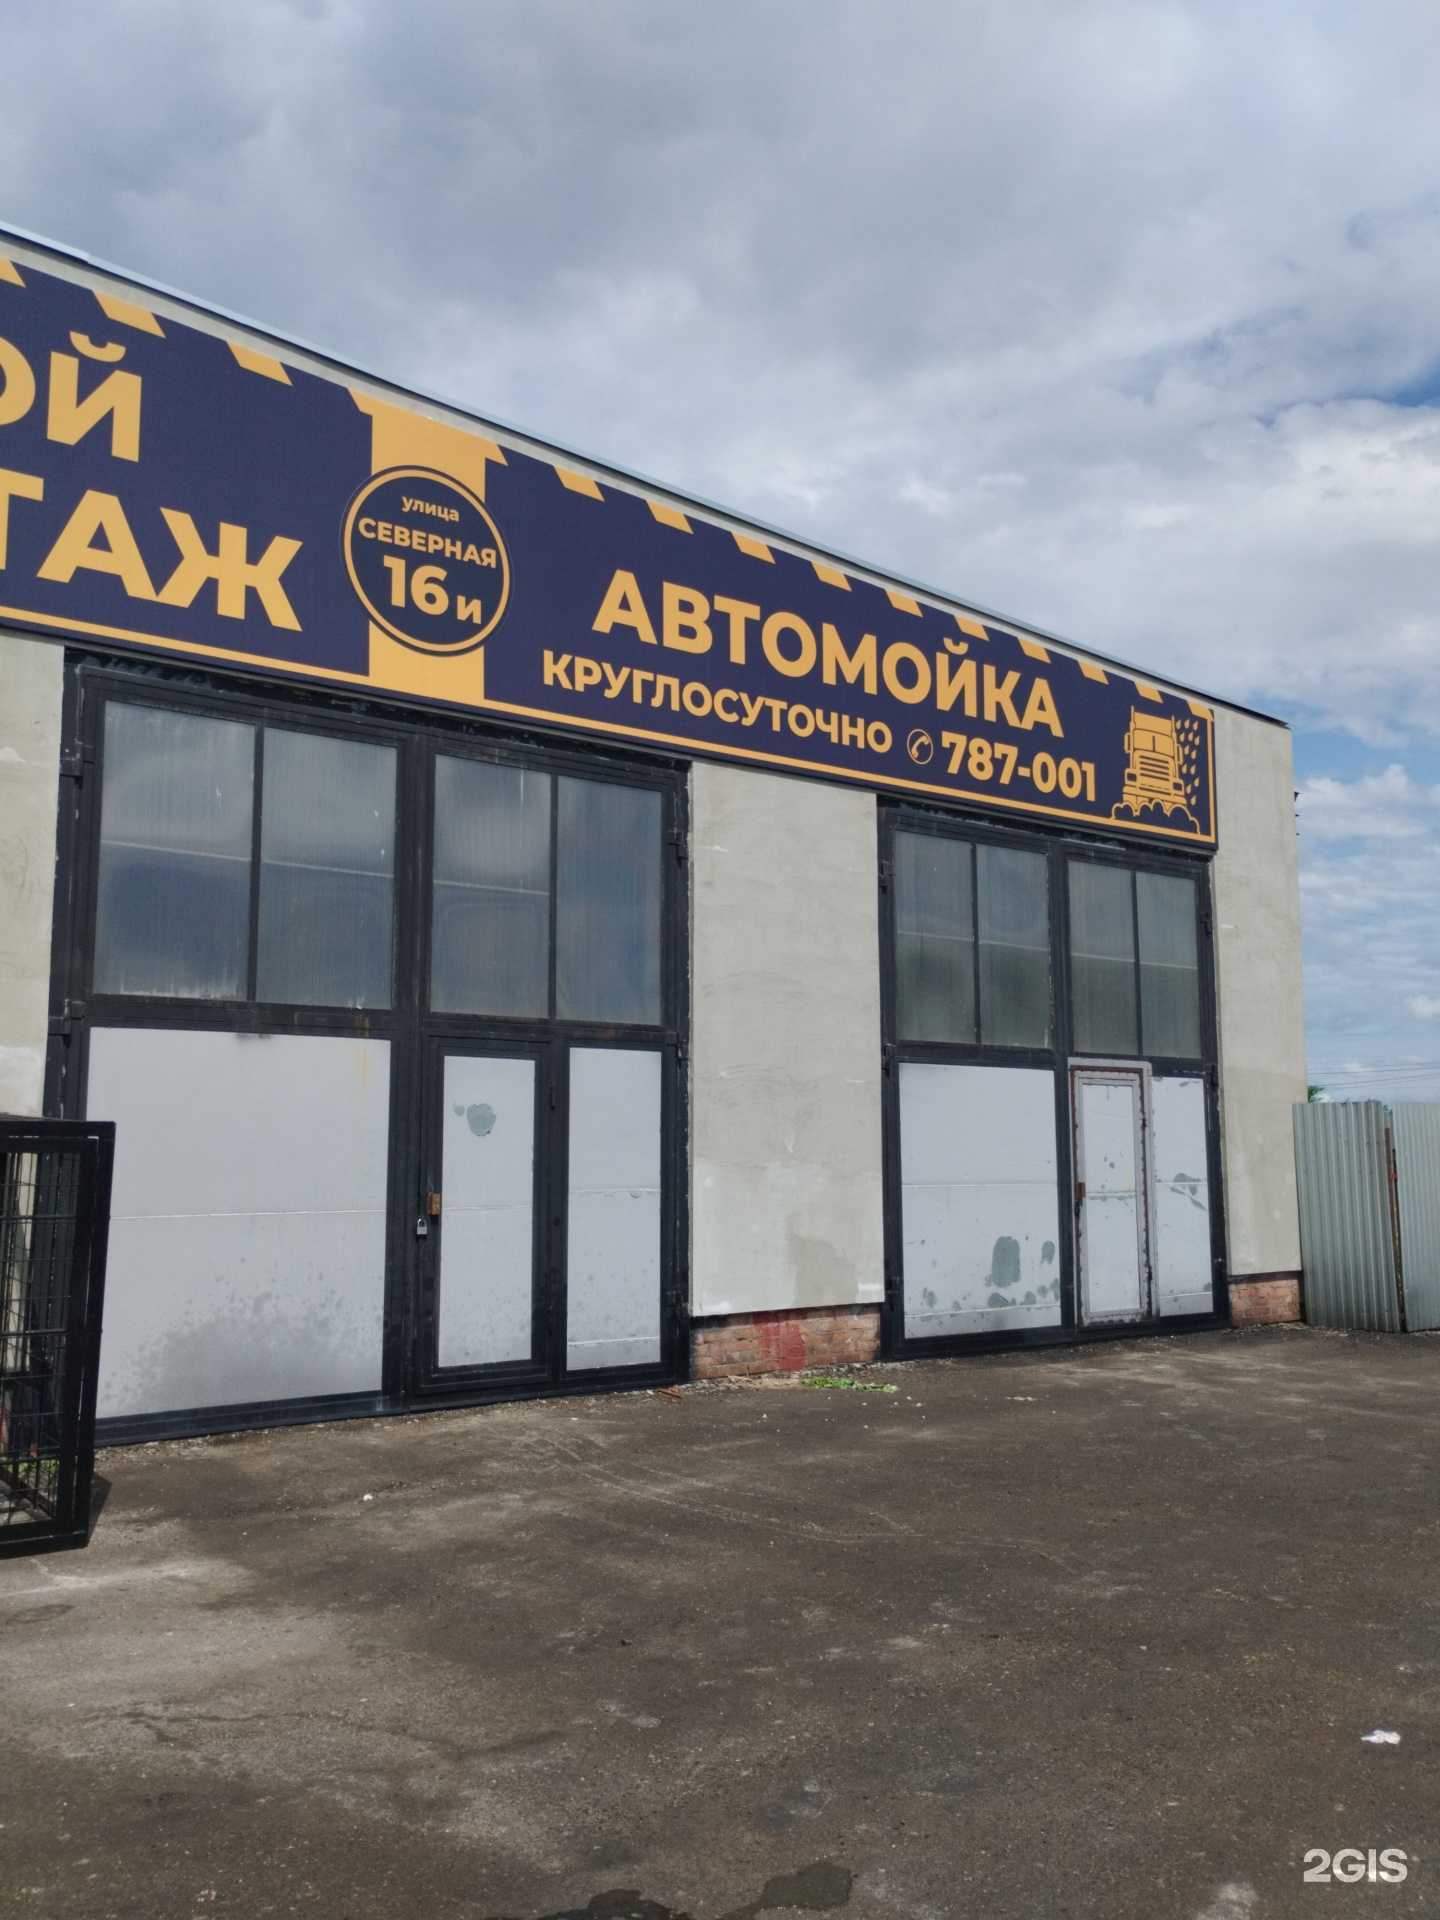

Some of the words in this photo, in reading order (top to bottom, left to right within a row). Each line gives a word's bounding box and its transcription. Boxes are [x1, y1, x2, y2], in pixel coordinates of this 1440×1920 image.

[401, 496, 460, 522] улица
[358, 517, 497, 569] СЕВЕРНАЯ
[383, 554, 449, 616] 16
[592, 569, 1065, 737] АВТОМОЙКА
[543, 649, 893, 753] КРУГЛОСУТОЧНО
[940, 730, 1096, 802] 787-001
